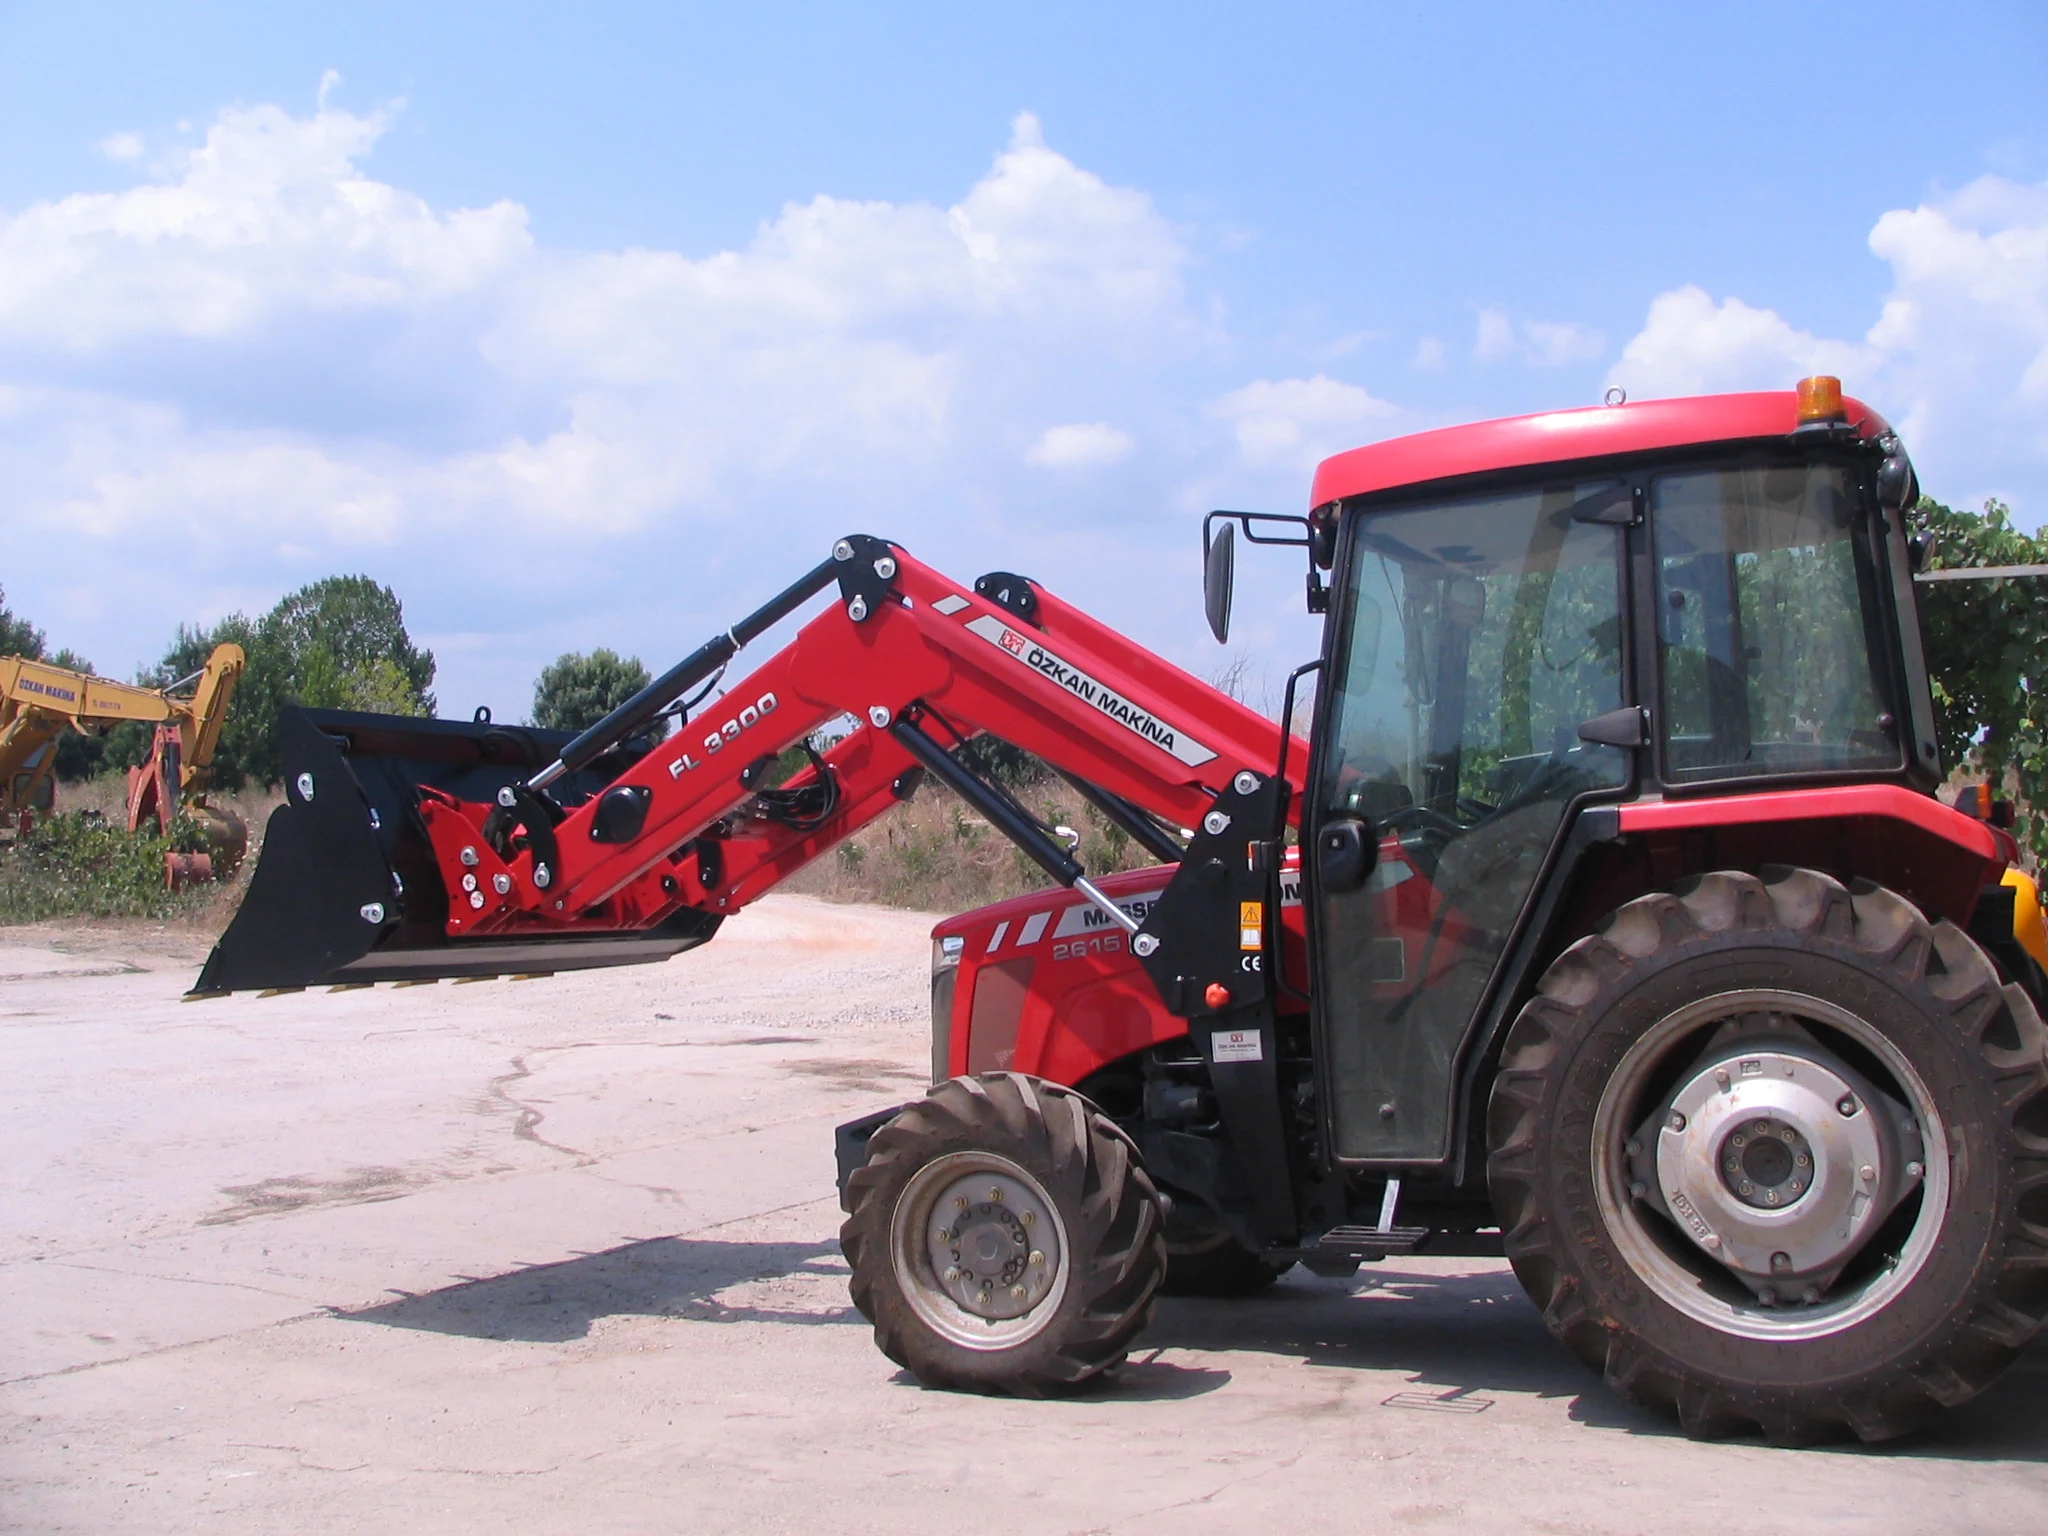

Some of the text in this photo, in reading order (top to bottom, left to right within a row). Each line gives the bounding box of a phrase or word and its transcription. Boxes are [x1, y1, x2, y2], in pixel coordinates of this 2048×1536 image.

[1028, 648, 1174, 750] ÖZKAN MAKİNA
[668, 692, 778, 780] FL 3300
[1053, 936, 1120, 961] 2615
[1241, 956, 1261, 972] CE
